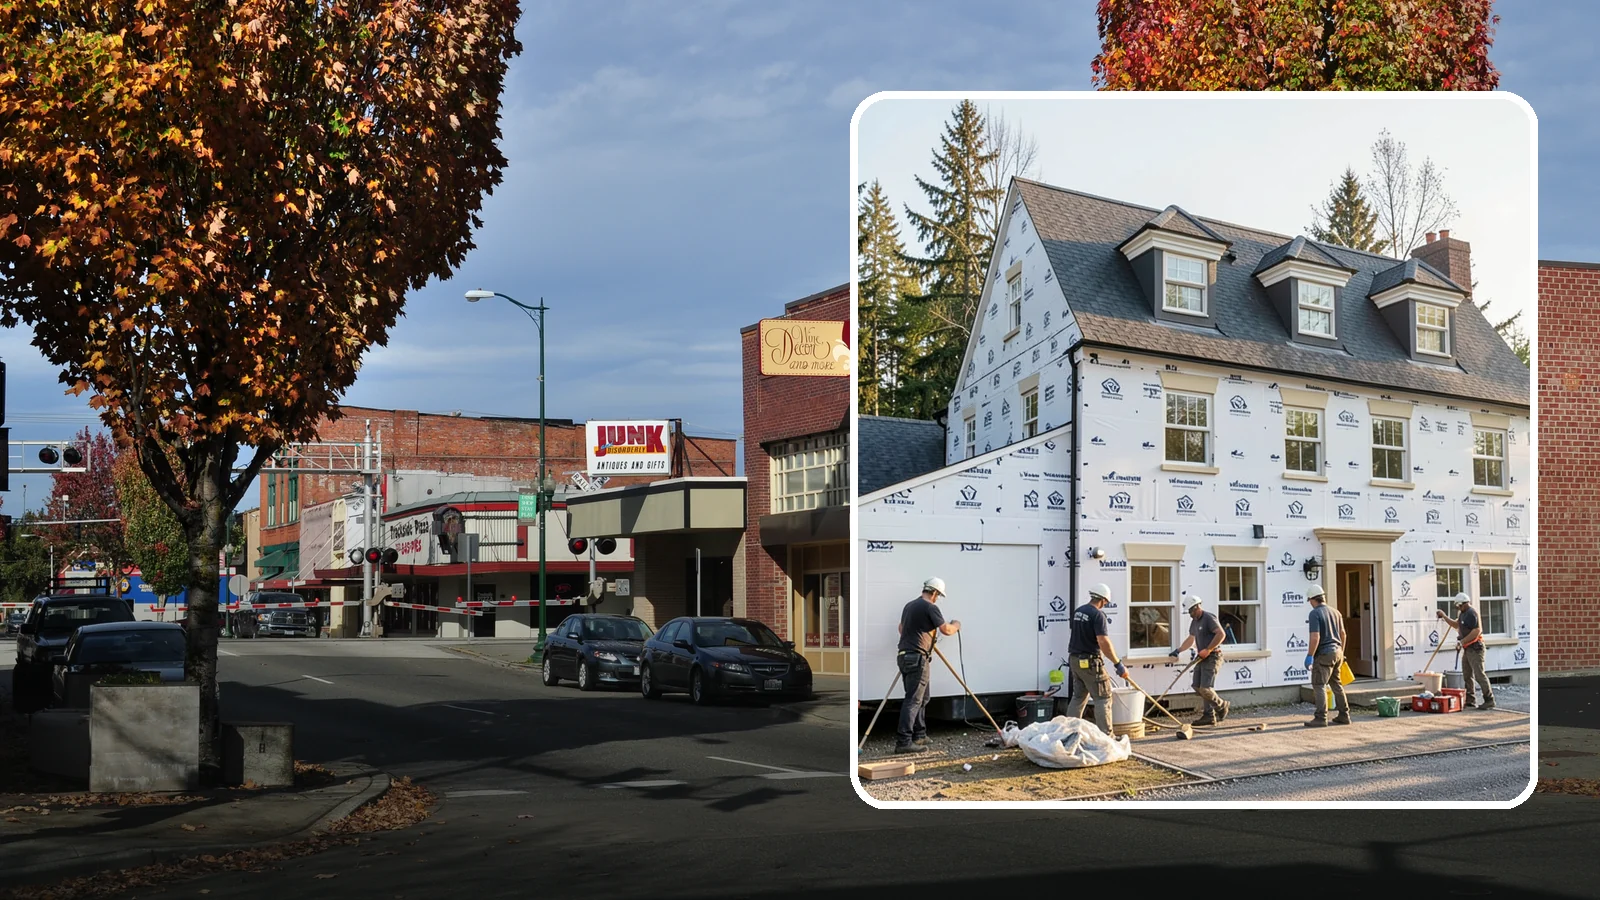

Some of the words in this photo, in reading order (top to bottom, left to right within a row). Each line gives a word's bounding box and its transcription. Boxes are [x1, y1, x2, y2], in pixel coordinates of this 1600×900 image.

[764, 327, 831, 365] Decor
[595, 425, 665, 457] JUNK
[607, 446, 646, 454] DISORDERLY
[596, 461, 628, 470] ANTIQUES
[631, 461, 644, 470] AND
[647, 460, 665, 470] GIFTS
